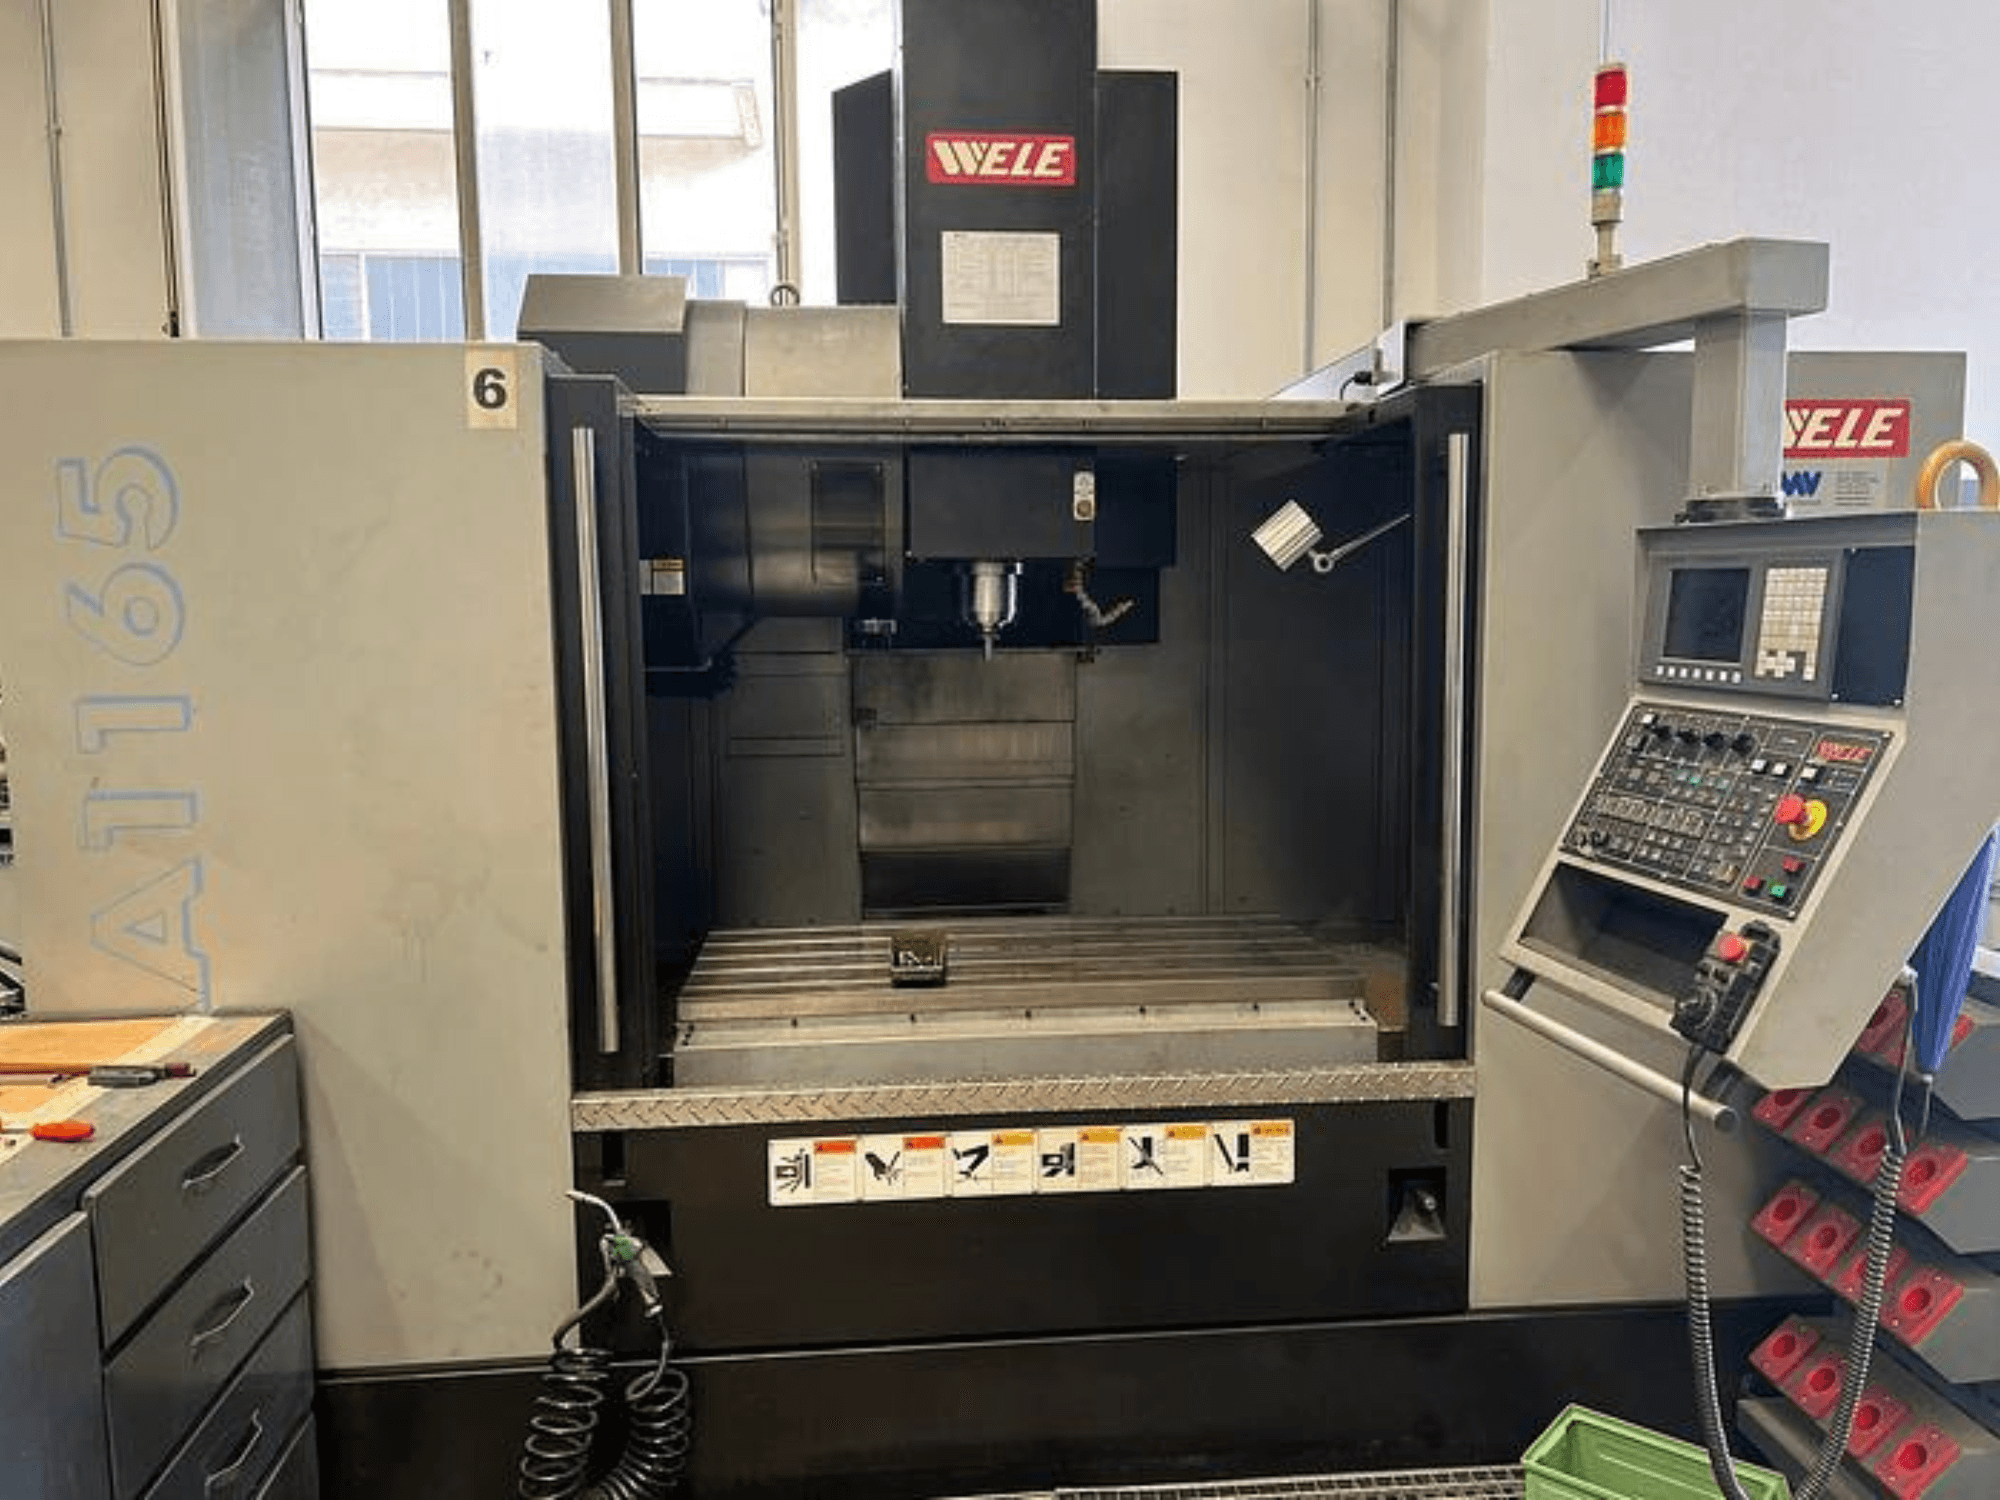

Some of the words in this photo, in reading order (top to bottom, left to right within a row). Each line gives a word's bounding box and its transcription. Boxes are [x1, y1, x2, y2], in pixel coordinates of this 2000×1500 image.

[932, 140, 1069, 176] WELE
[474, 368, 507, 410] 6
[56, 445, 212, 1012] A1165
